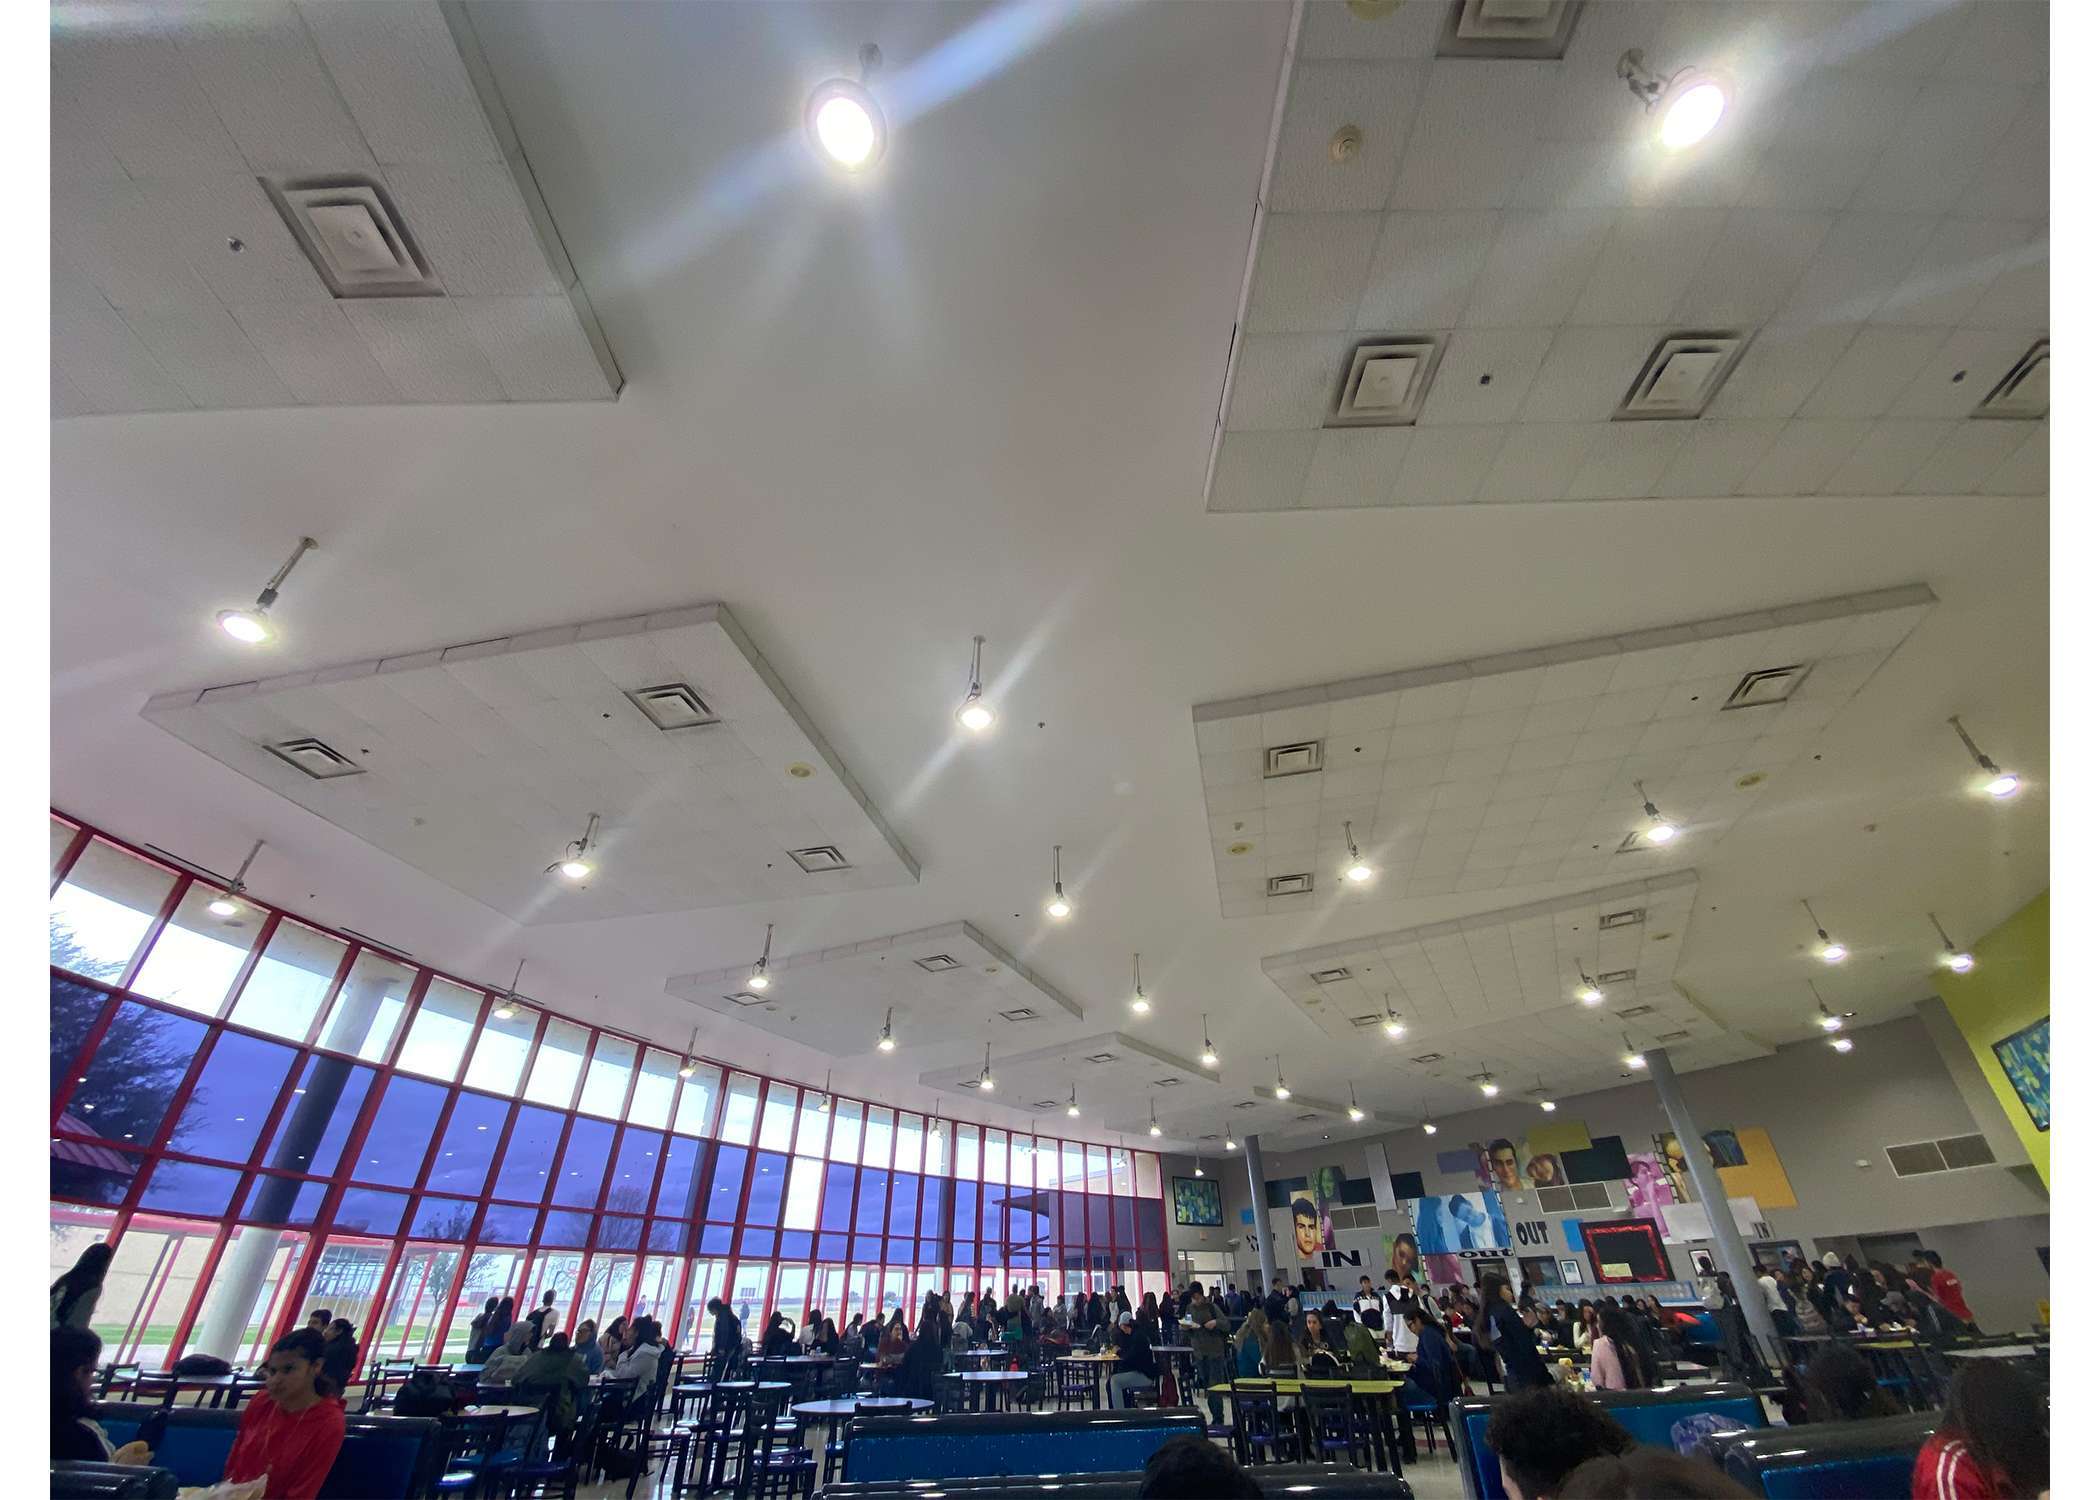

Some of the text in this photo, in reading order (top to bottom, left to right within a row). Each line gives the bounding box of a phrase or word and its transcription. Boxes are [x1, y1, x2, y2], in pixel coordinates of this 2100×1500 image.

[1516, 1221, 1548, 1245] OUT
[1321, 1250, 1362, 1267] IN
[1459, 1248, 1514, 1258] out
